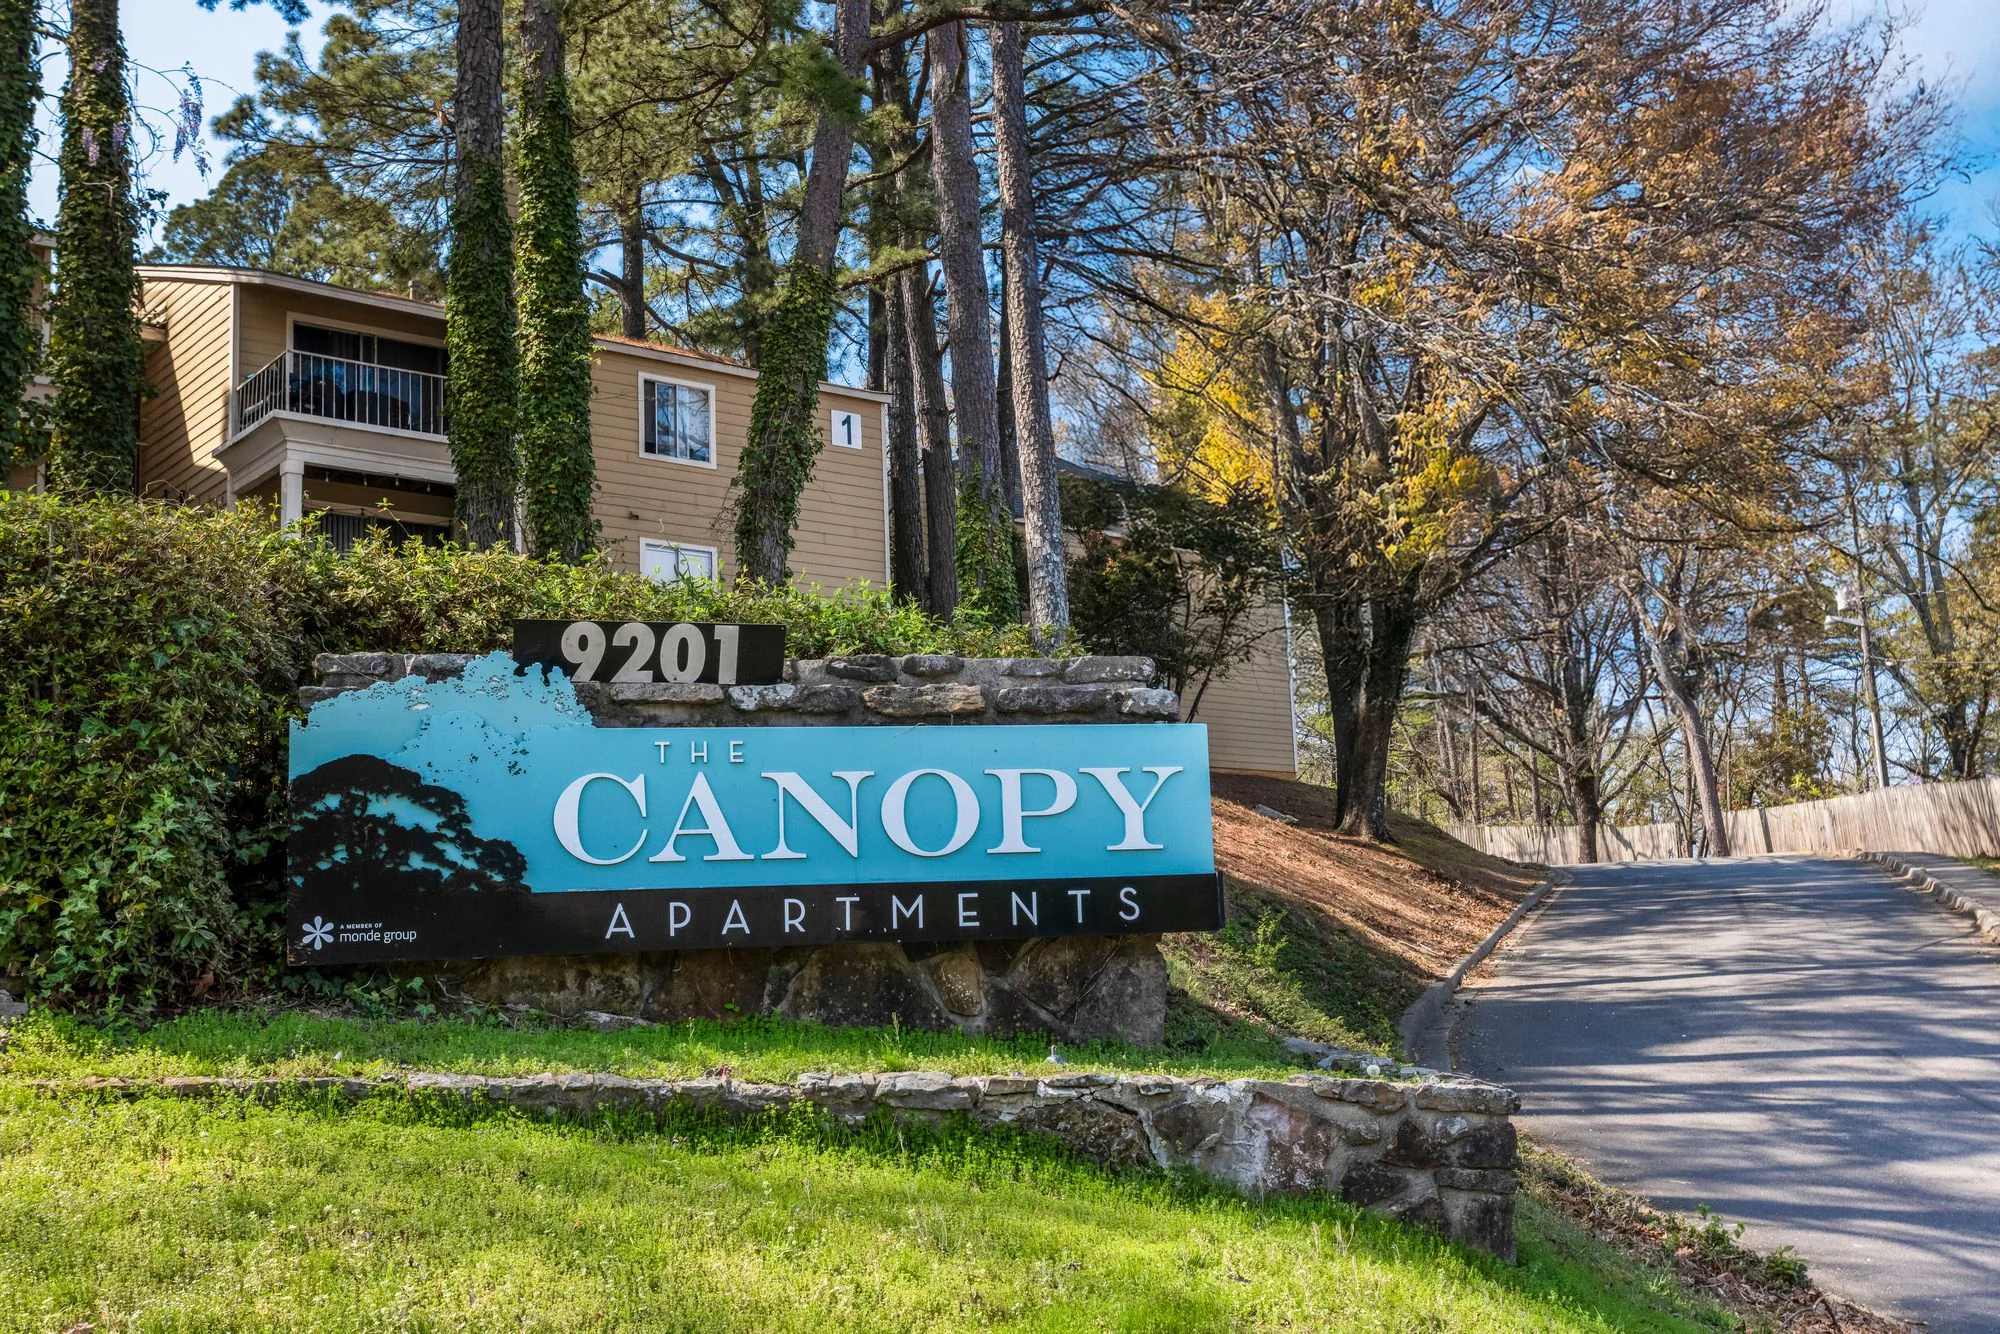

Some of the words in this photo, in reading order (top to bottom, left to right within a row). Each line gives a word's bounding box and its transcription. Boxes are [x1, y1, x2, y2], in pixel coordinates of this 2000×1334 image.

[842, 414, 852, 445] 1
[561, 621, 740, 685] 9201
[654, 740, 745, 764] THE
[553, 766, 1185, 866] CANOPY
[605, 886, 1140, 940] APARTMENTS
[340, 930, 381, 942] monde
[383, 930, 417, 943] group
